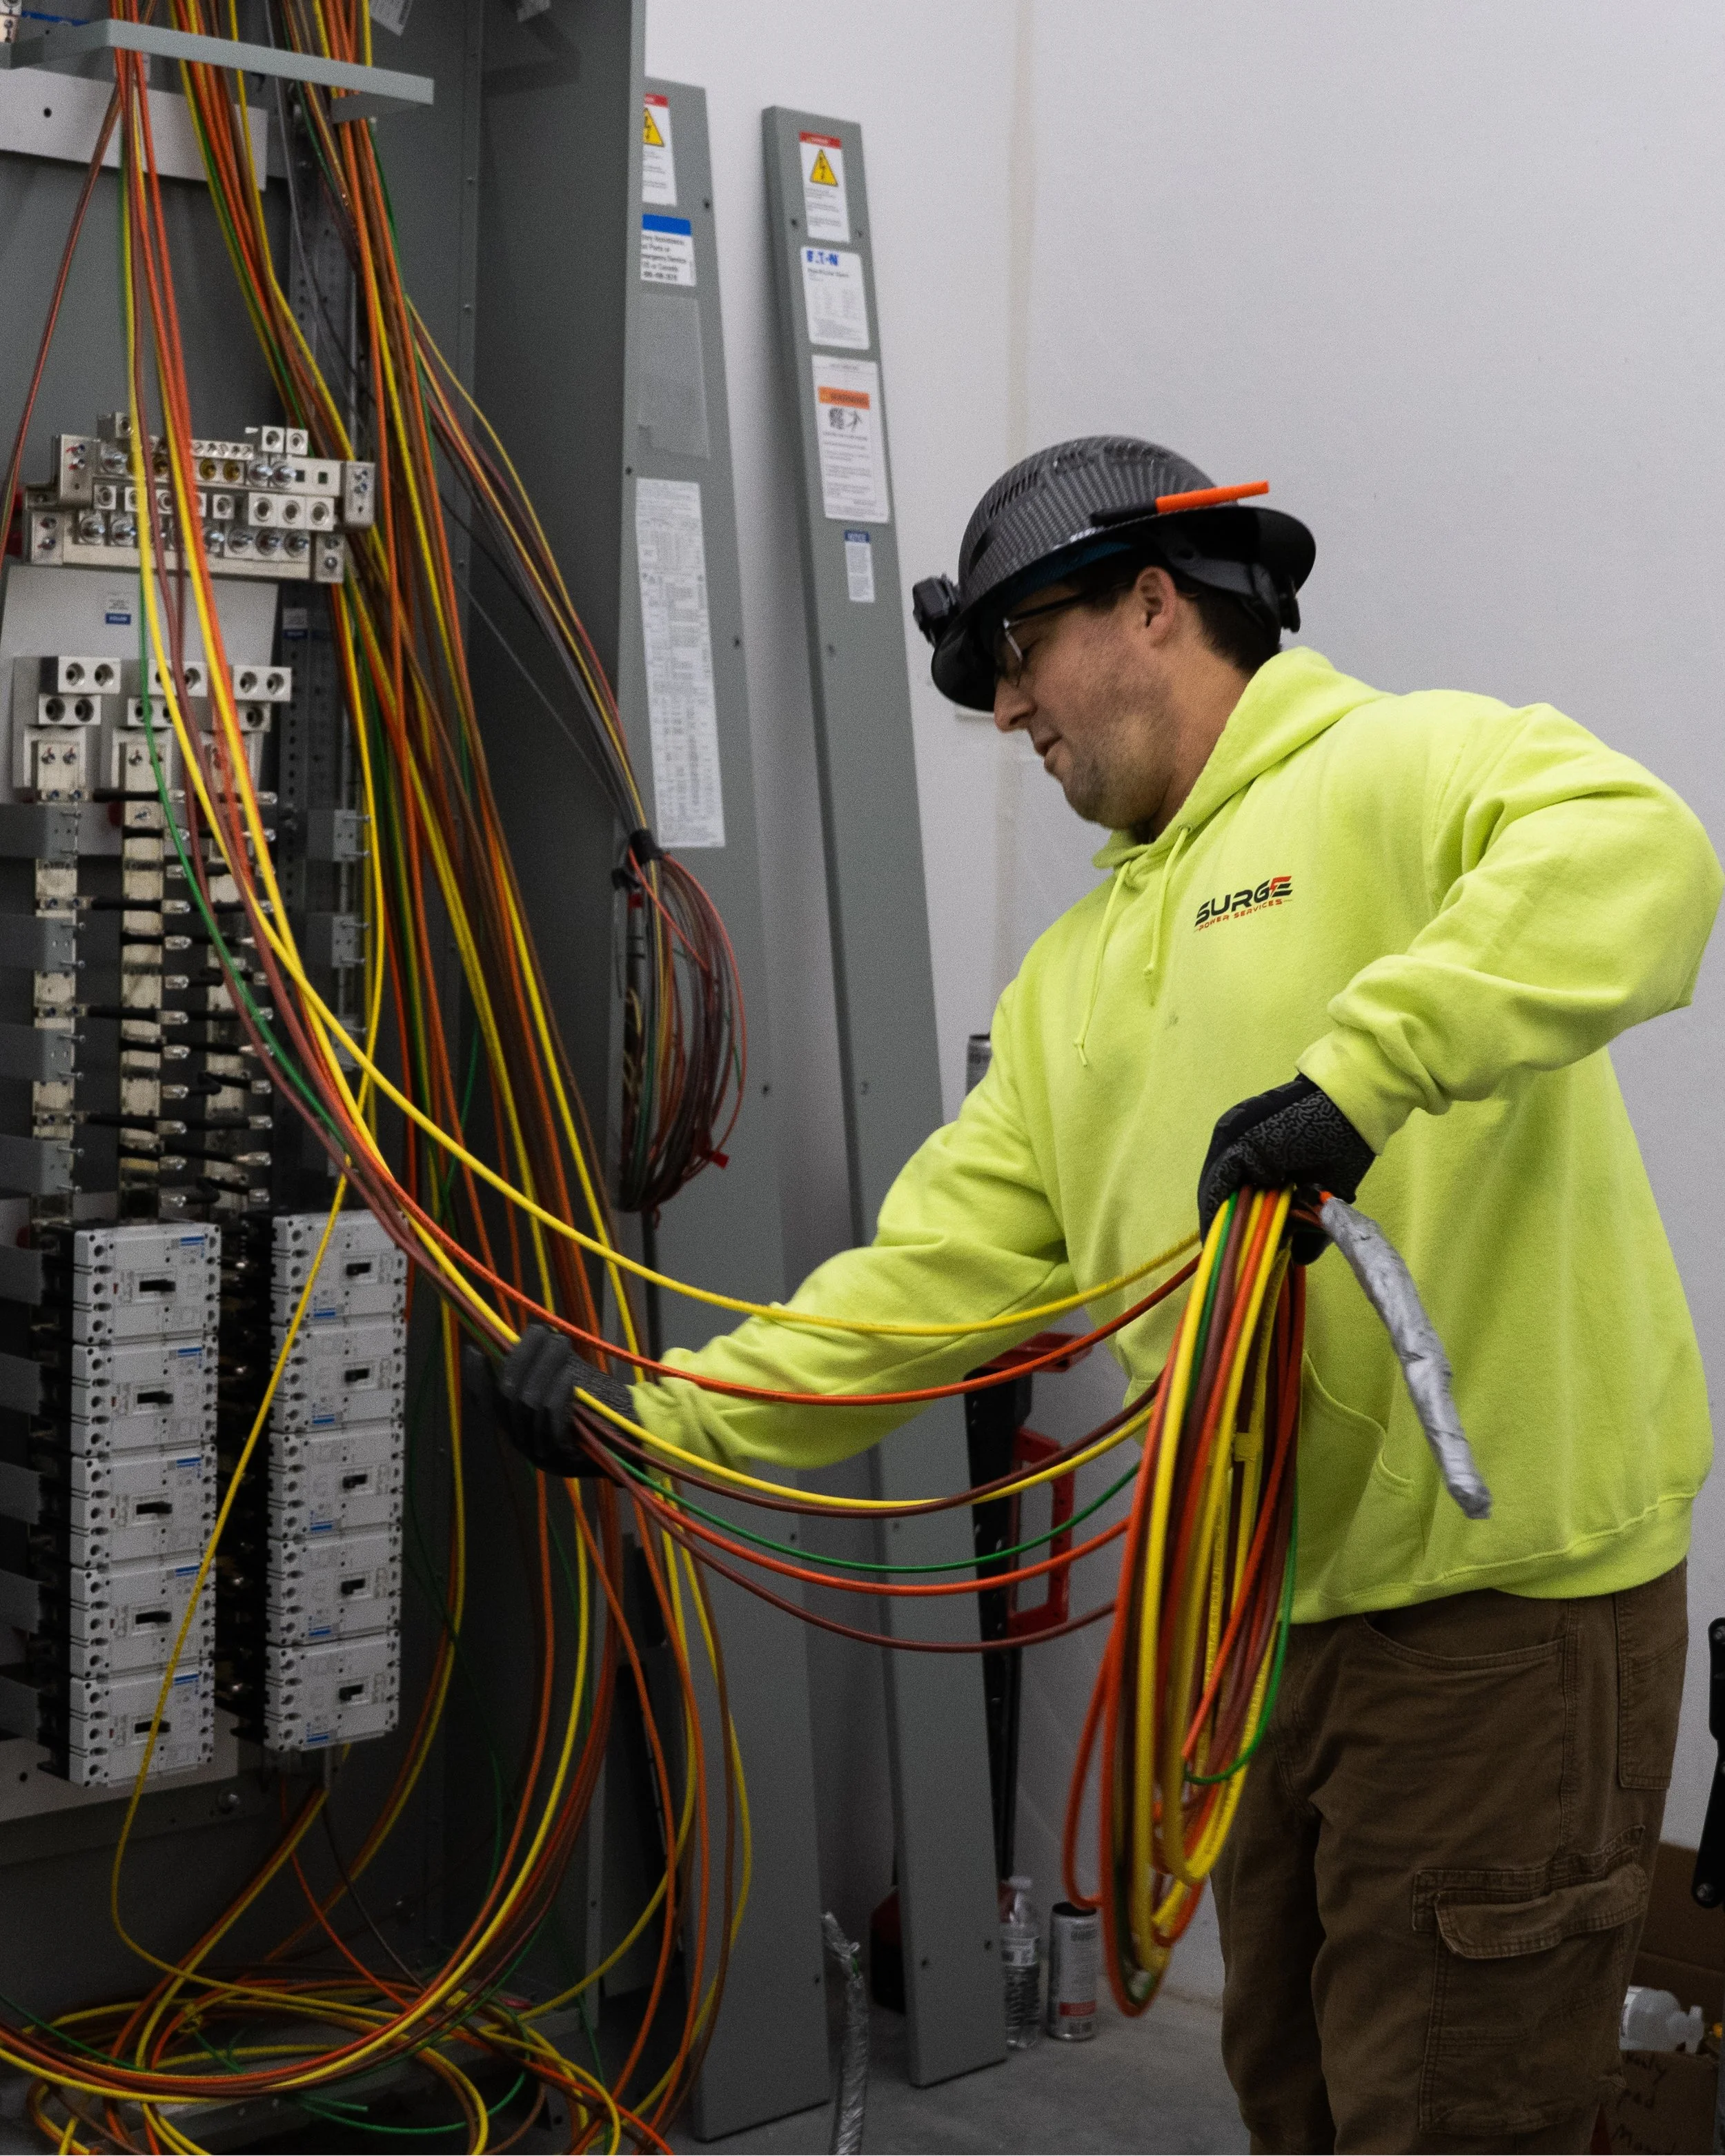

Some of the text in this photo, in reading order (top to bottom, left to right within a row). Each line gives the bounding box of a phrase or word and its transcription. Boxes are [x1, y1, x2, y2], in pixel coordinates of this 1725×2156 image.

[1195, 876, 1293, 927] SURGE
[1199, 898, 1283, 931] POWER SERVICES
